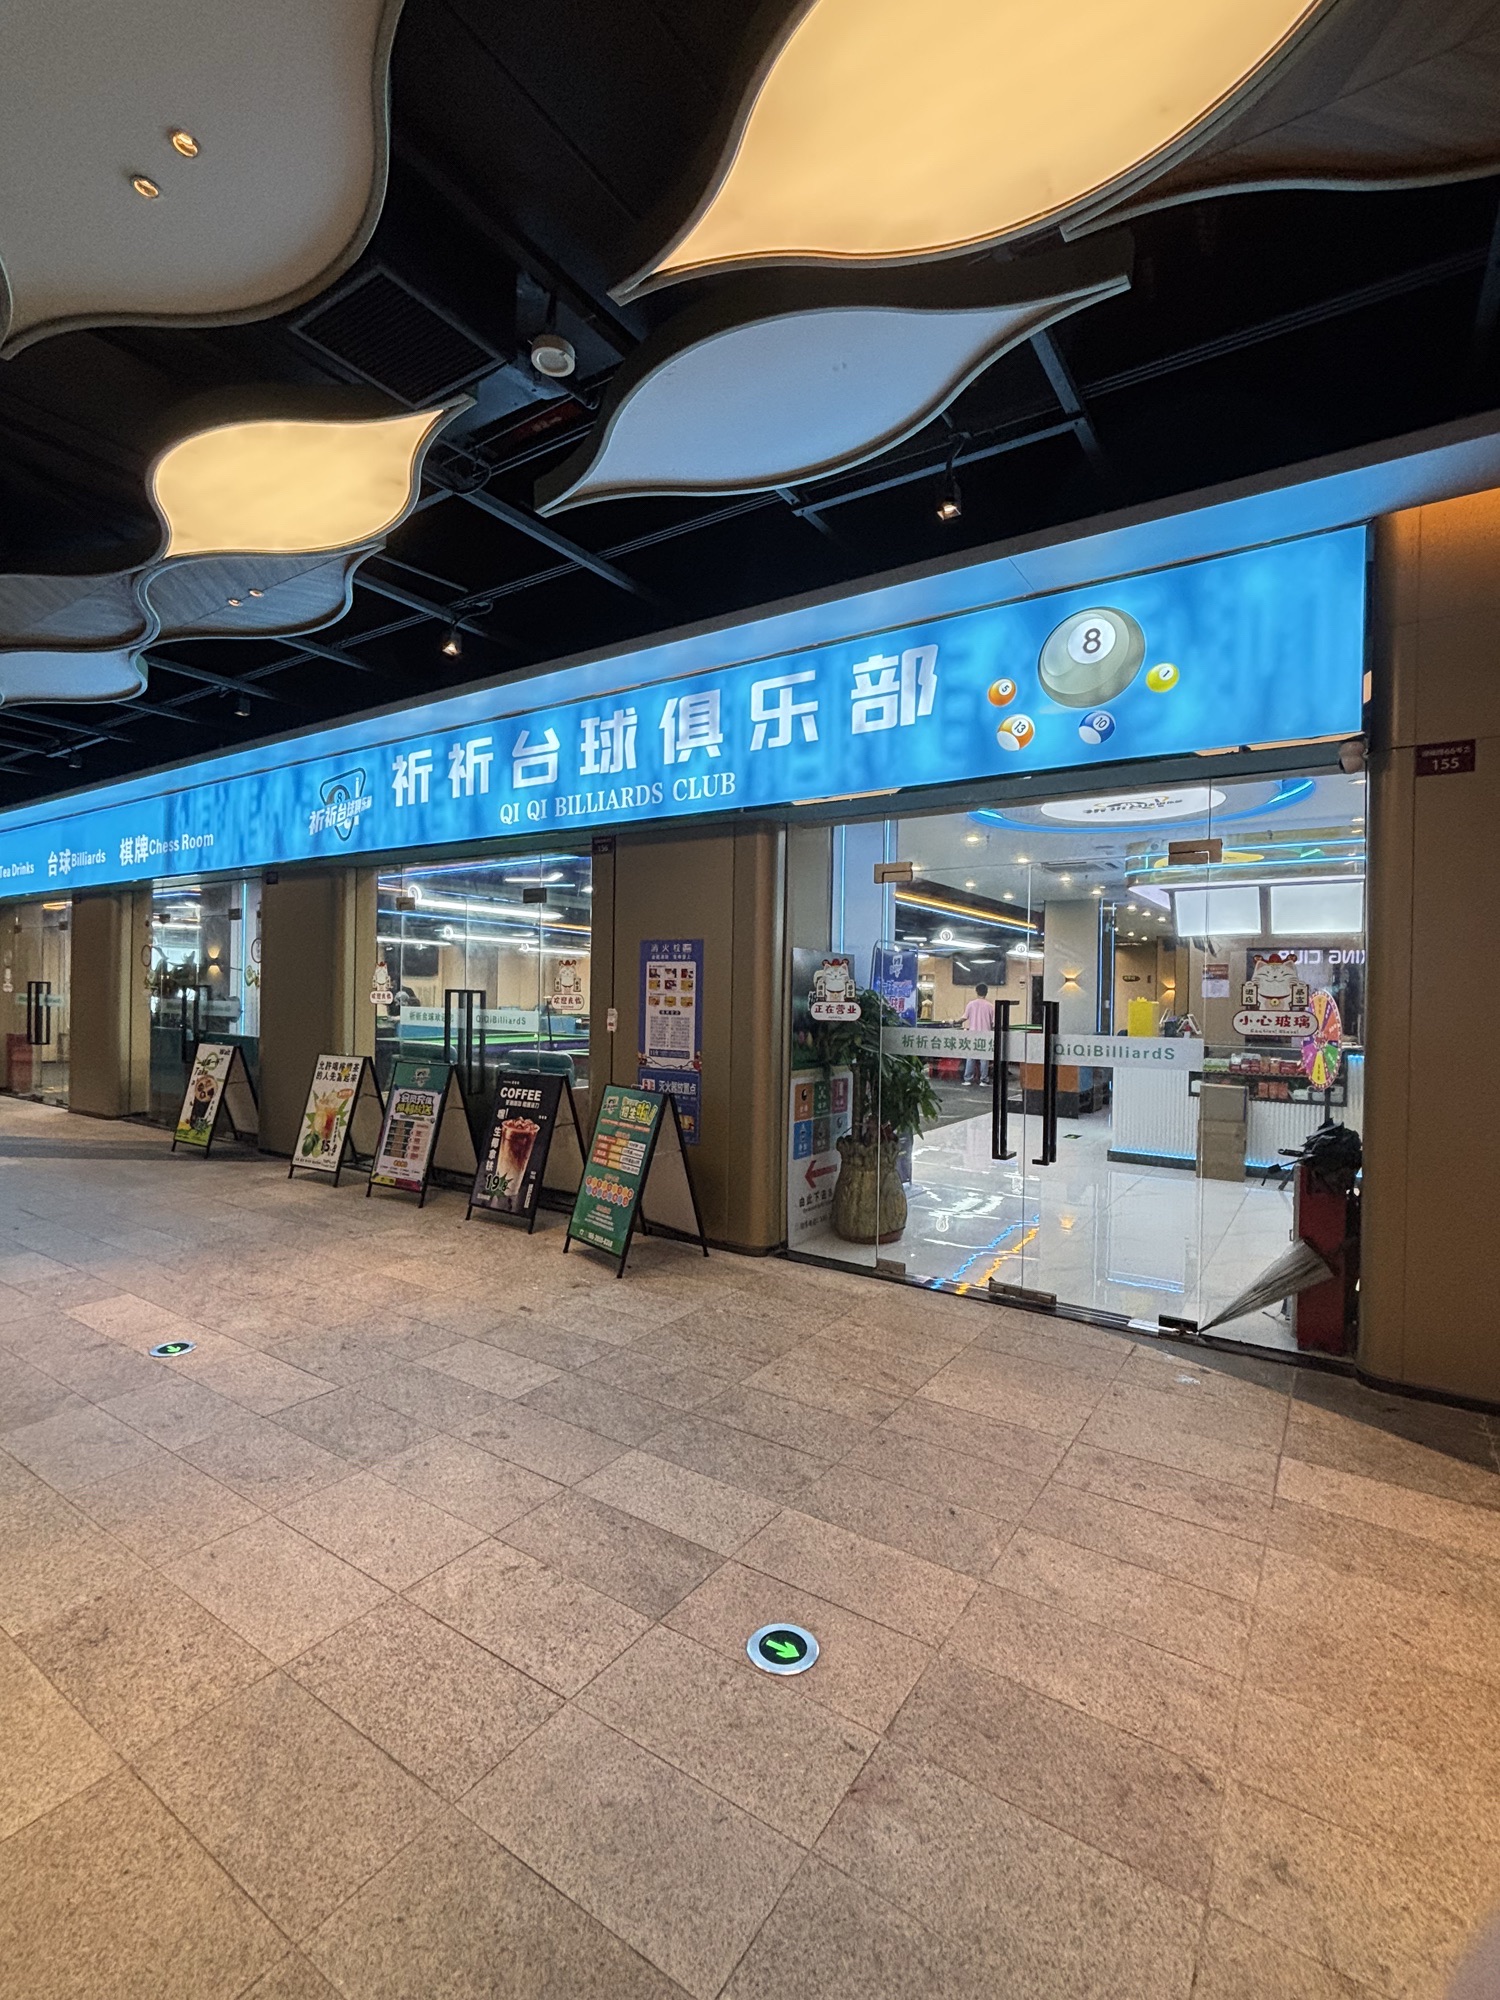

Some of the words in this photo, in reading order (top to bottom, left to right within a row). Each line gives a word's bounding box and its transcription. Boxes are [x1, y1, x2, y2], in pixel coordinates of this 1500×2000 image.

[1082, 627, 1102, 654] 8
[1162, 669, 1171, 678] 1
[1001, 684, 1010, 693] 5
[391, 643, 939, 807] 祈祈台球俱乐部
[1013, 721, 1027, 734] 13
[1095, 717, 1108, 729] 10
[1432, 757, 1460, 771] 155
[500, 803, 520, 826] QI
[526, 799, 548, 823] QI
[554, 782, 663, 817] BILLIARDS
[672, 771, 736, 802] CLUB
[119, 836, 149, 867] 棋牌
[149, 836, 180, 855] Chess
[182, 832, 214, 850] Room
[47, 848, 72, 878] 台球
[71, 851, 107, 867] Billiards
[11, 861, 35, 877] Drinks
[814, 1003, 857, 1015] 正在营业
[1239, 1014, 1311, 1029] 小心玻璃
[1054, 1042, 1175, 1061] QiQiBilliardS
[500, 1086, 542, 1102] COFFEE
